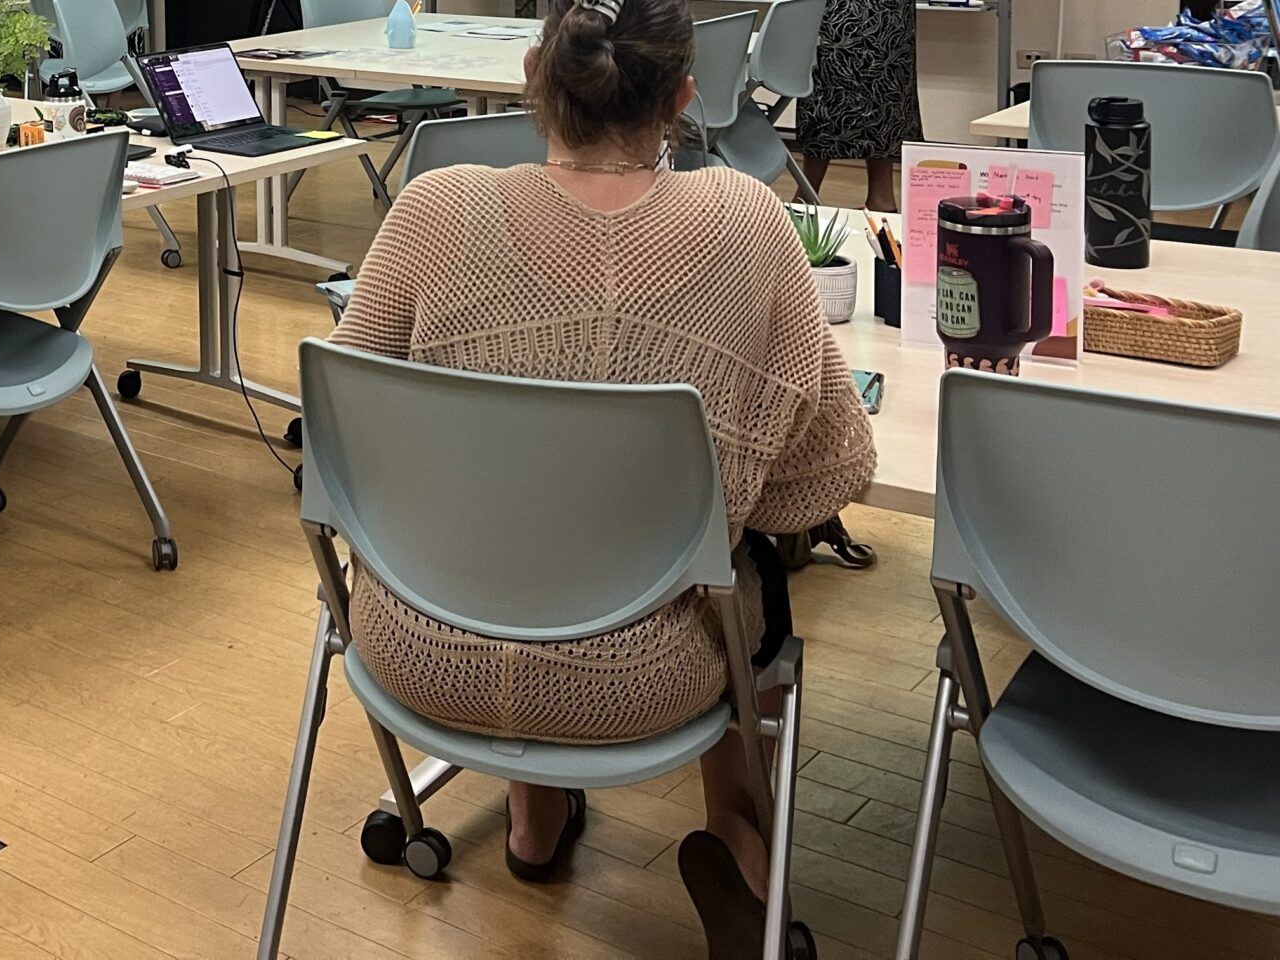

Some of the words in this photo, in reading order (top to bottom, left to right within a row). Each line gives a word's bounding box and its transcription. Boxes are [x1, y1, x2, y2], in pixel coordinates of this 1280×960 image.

[959, 291, 976, 302] CAN
[945, 302, 954, 311] NO
[956, 303, 972, 314] CAN
[941, 312, 949, 322] NO
